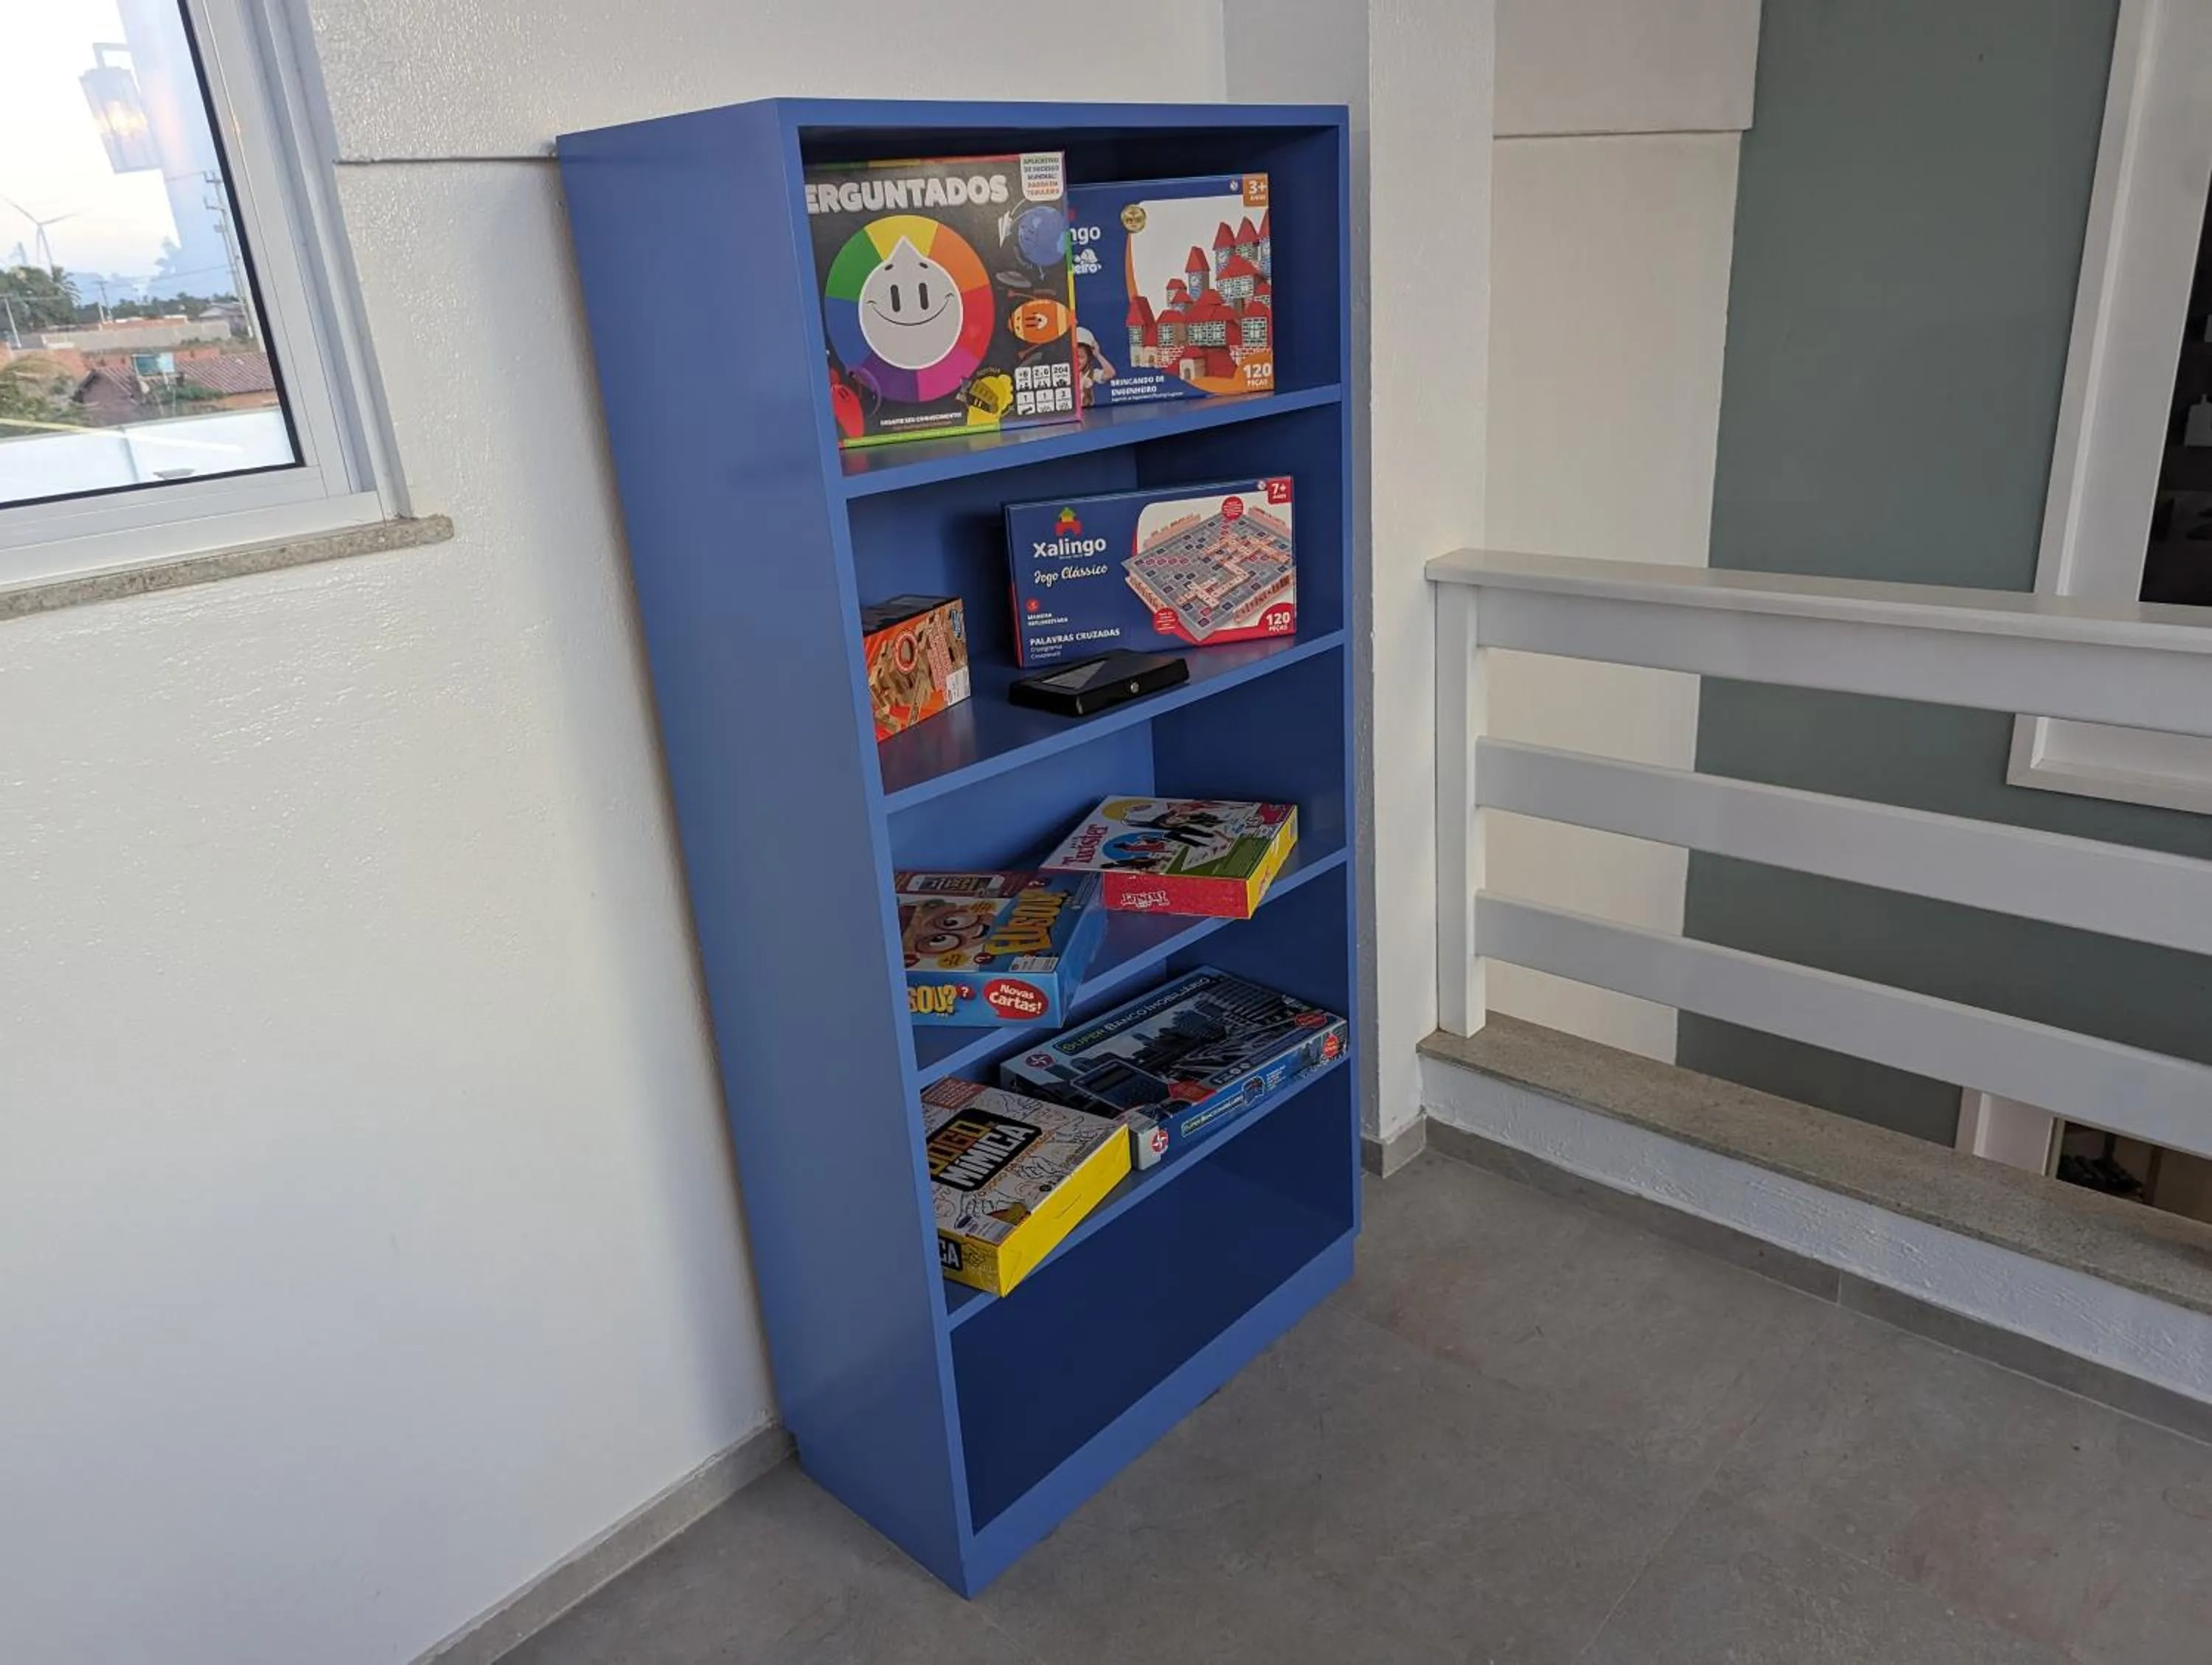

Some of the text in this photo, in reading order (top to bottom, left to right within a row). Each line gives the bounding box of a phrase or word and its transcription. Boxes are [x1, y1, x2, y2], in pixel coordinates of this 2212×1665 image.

[804, 175, 1008, 214] ERGUNTADOS
[1248, 180, 1267, 194] 3+
[1243, 363, 1271, 378] 120
[1271, 483, 1286, 494] 7+
[1034, 570, 1058, 587] Jogo
[1266, 611, 1290, 625] 120
[1030, 628, 1121, 646] PALAVRAS CRUZADAS
[1000, 984, 1034, 999] Novas
[989, 992, 1042, 1015] Cartas!
